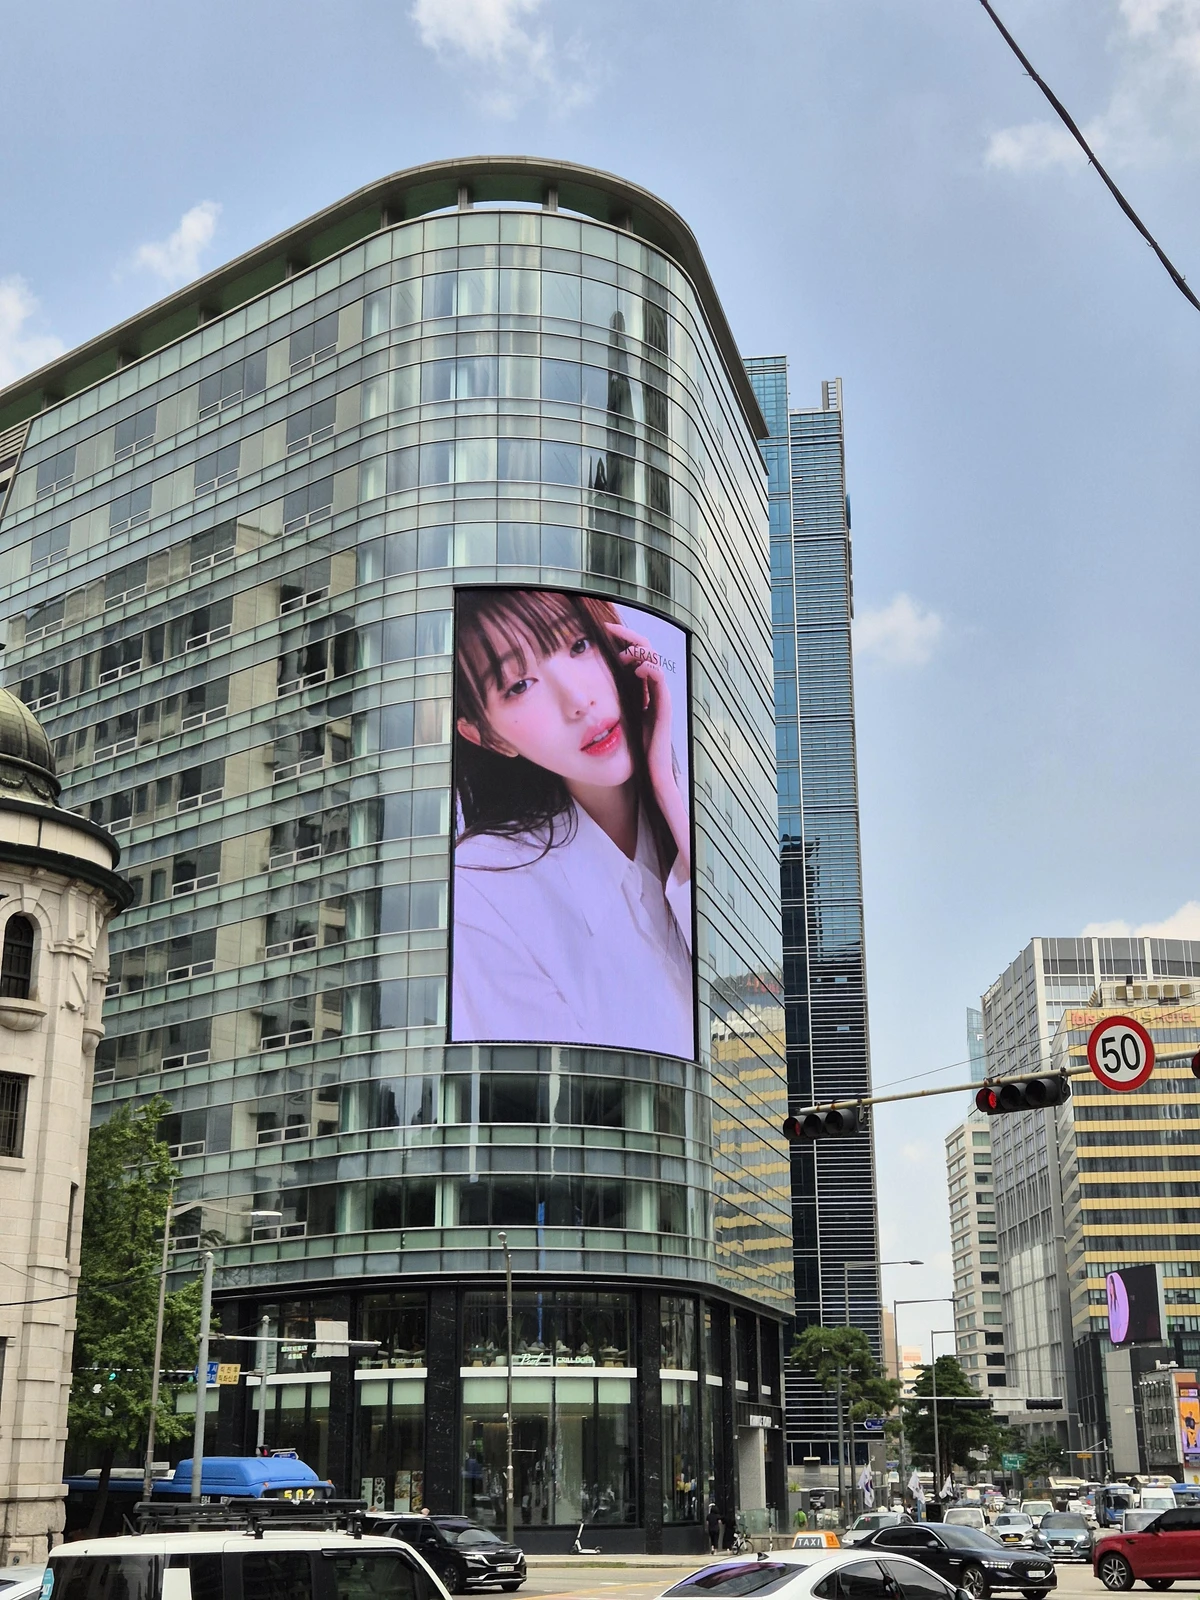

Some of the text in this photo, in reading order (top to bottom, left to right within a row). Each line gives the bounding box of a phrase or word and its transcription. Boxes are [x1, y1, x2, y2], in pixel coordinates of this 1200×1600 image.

[625, 643, 677, 674] KÉRASTASE
[1071, 1012, 1096, 1025] ibis
[1101, 1035, 1140, 1074] 50
[390, 1357, 422, 1365] Restaurant
[284, 1488, 316, 1500] 502
[798, 1538, 820, 1547] TAXI
